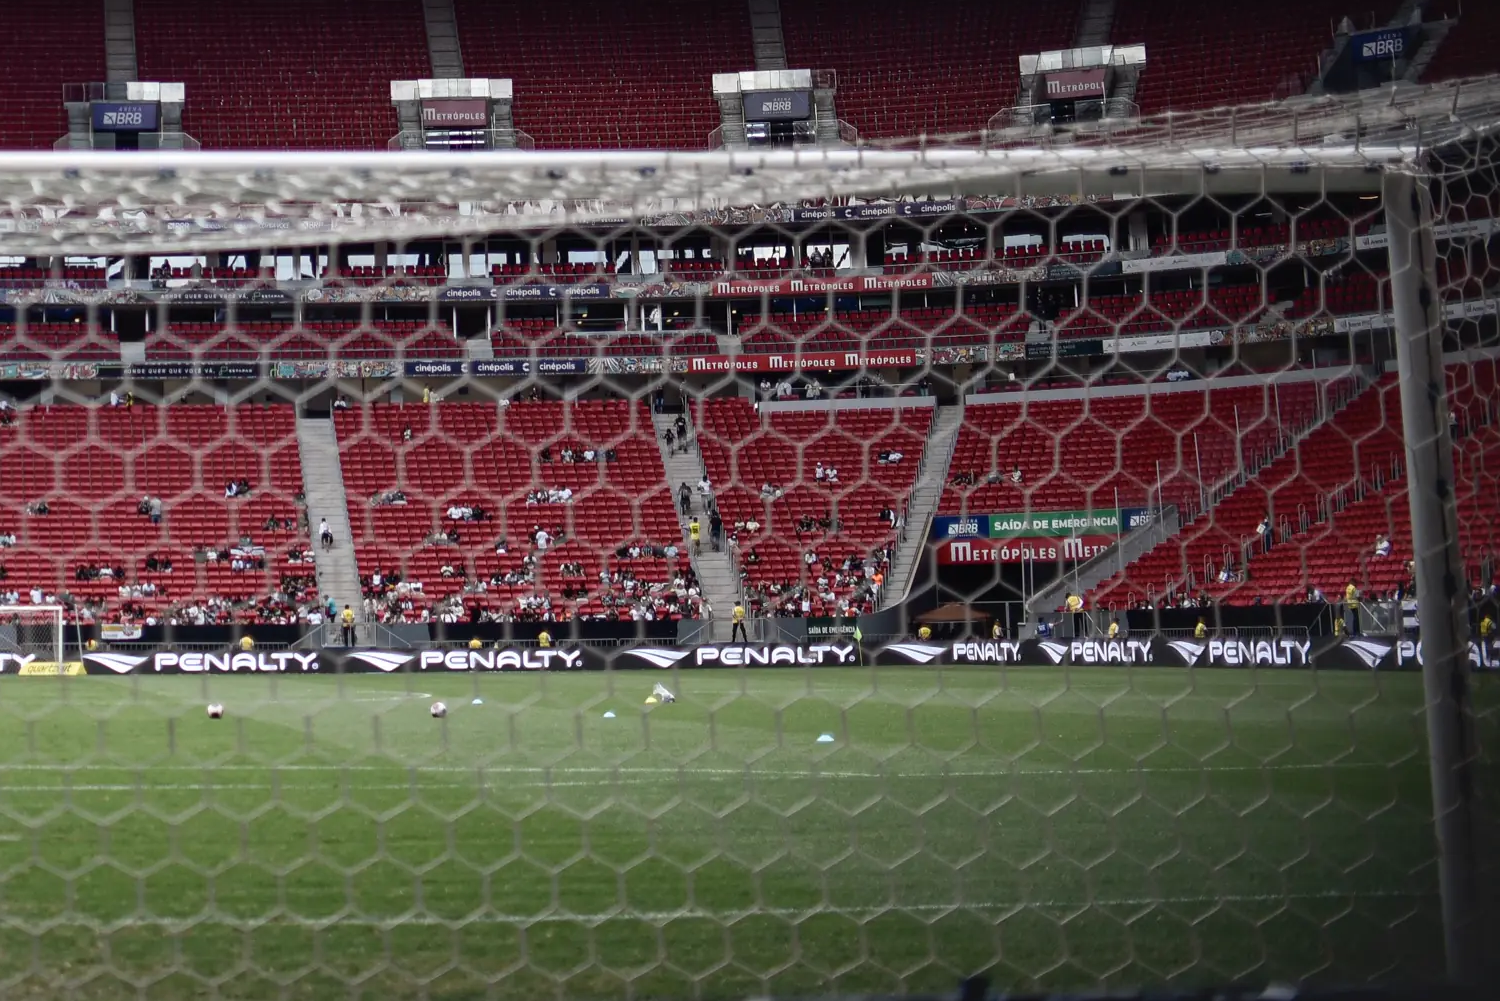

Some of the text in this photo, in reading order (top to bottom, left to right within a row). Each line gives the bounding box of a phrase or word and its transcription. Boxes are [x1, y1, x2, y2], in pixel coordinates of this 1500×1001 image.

[1377, 38, 1403, 54] BRB
[422, 107, 486, 121] METRÓPOLES
[772, 101, 792, 111] BRB
[116, 112, 142, 125] BRB
[861, 206, 896, 217] cinépolis
[921, 203, 956, 213] cinépolis
[446, 288, 481, 298] cinépolis
[506, 287, 541, 297] cinépolis
[565, 286, 600, 295] cinépolis
[717, 277, 928, 294] METRÓPOLES METRÓPOLES METRÓPOLES
[415, 362, 451, 373] cinépolis
[477, 362, 514, 372] cinépolis
[539, 361, 576, 371] cinépolis
[692, 353, 911, 370] METRÓPOLES METRÓPOLES METRÓPOLES
[957, 523, 979, 534] BRB
[994, 516, 1118, 531] SAÍDA DE EMERGNCIA
[950, 541, 1057, 562] METRÓPOLES
[696, 645, 854, 666] PENALTY
[952, 642, 1020, 662] PENALTY
[1071, 640, 1150, 663] PENALTY
[1208, 639, 1311, 666] PENALTY
[155, 651, 319, 671] PENALTY
[420, 649, 581, 671] PENALTY
